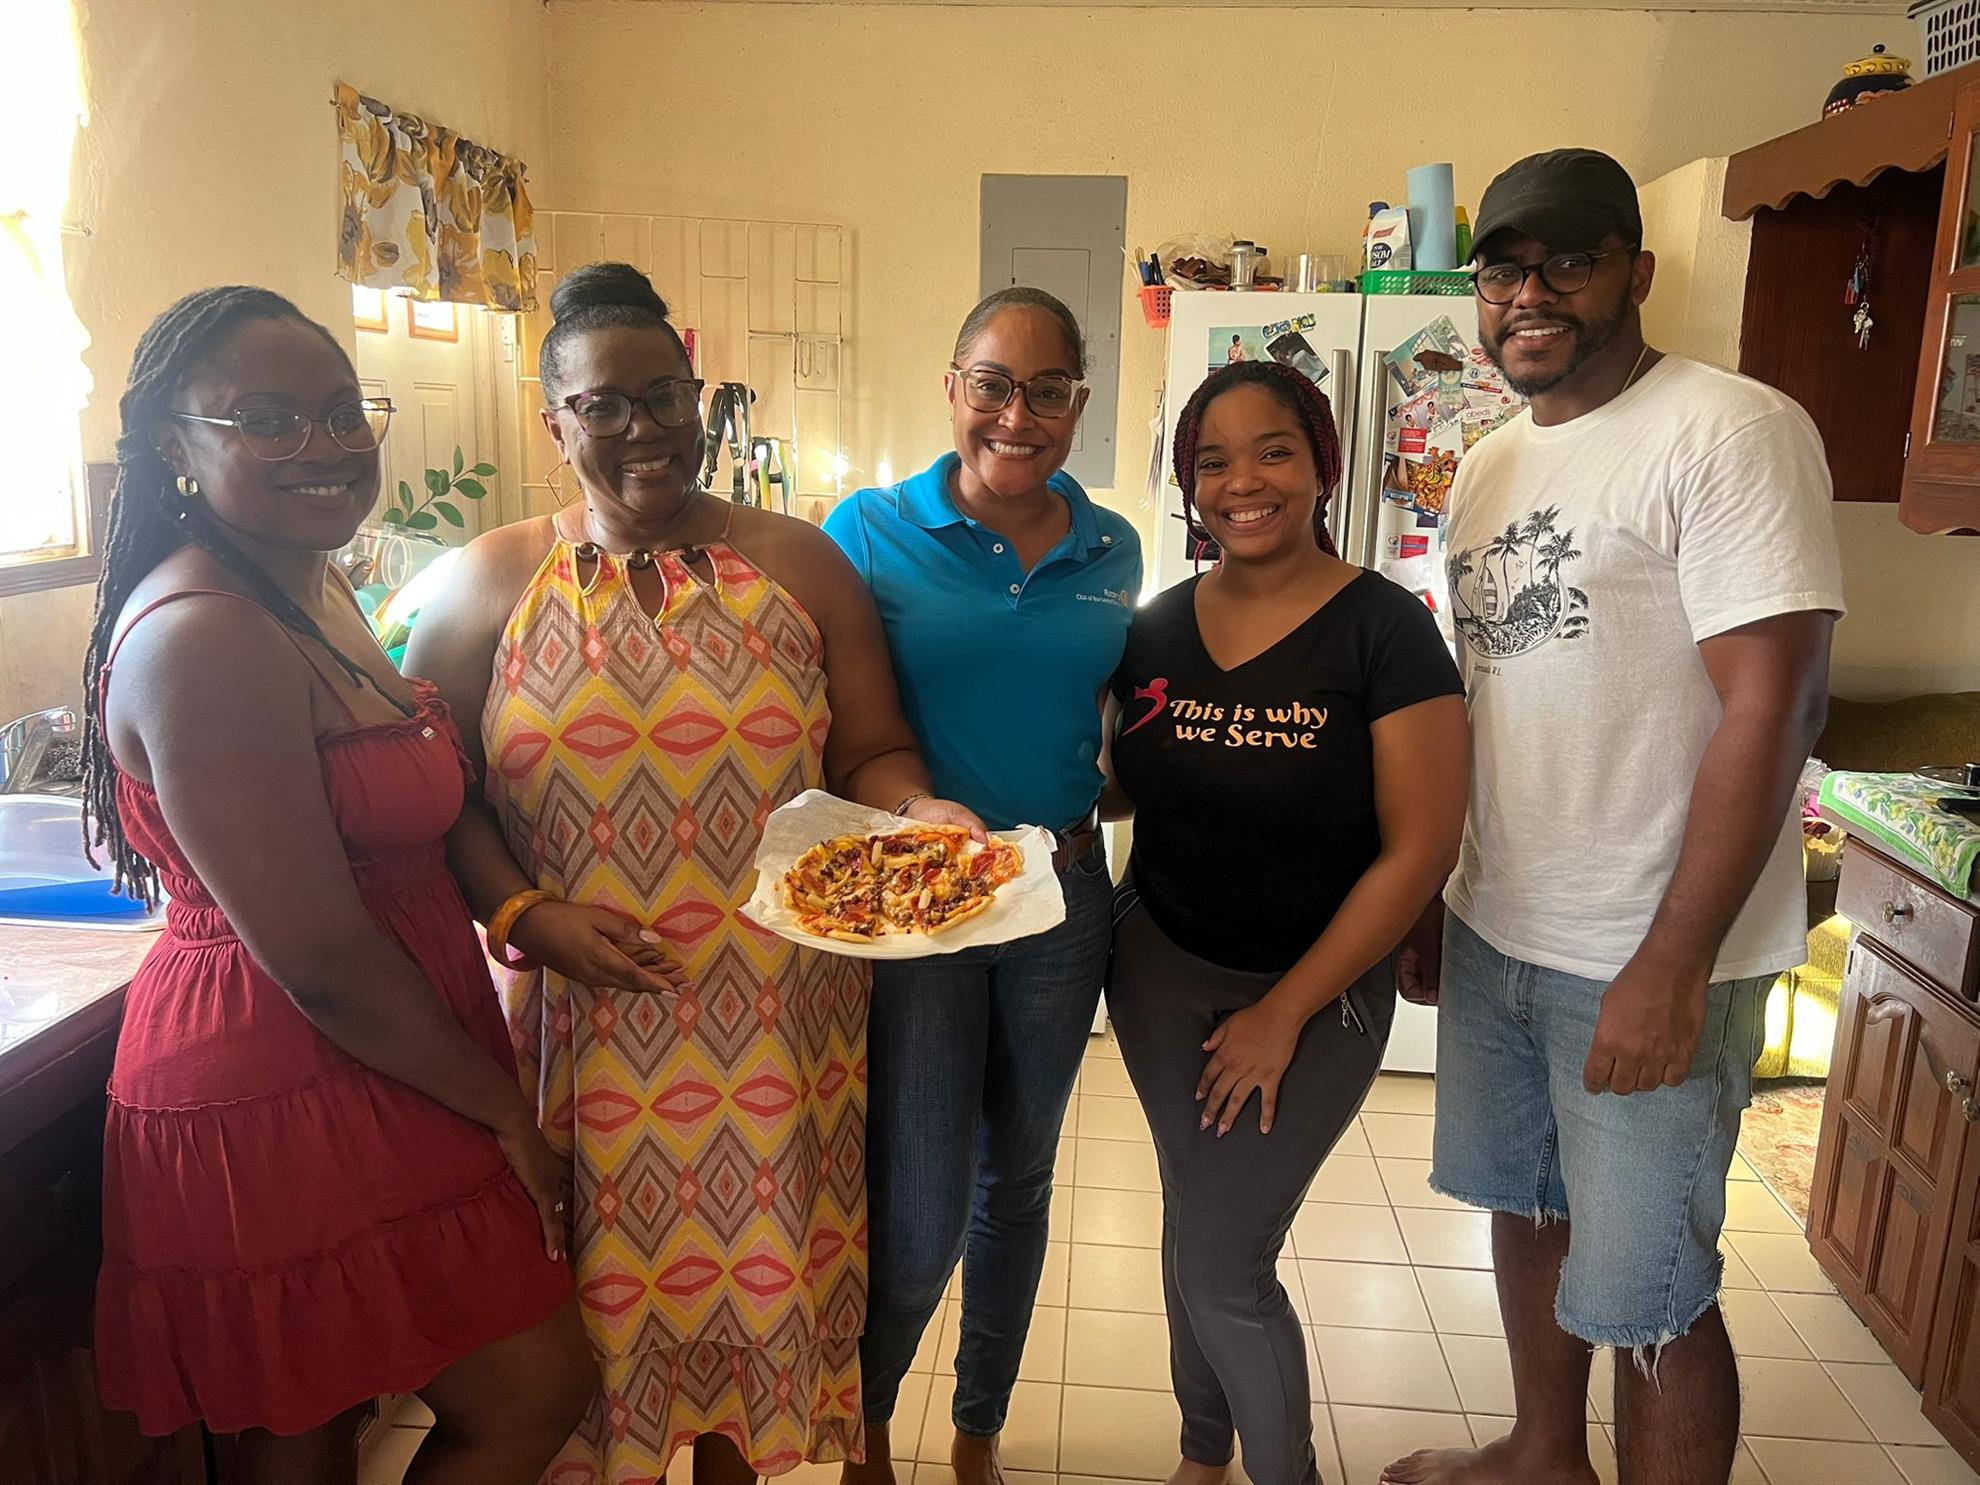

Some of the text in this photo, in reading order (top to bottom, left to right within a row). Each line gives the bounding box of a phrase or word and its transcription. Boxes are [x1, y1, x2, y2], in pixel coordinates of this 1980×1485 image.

[1169, 699, 1328, 729] This is why
[1175, 723, 1318, 749] we Serve
